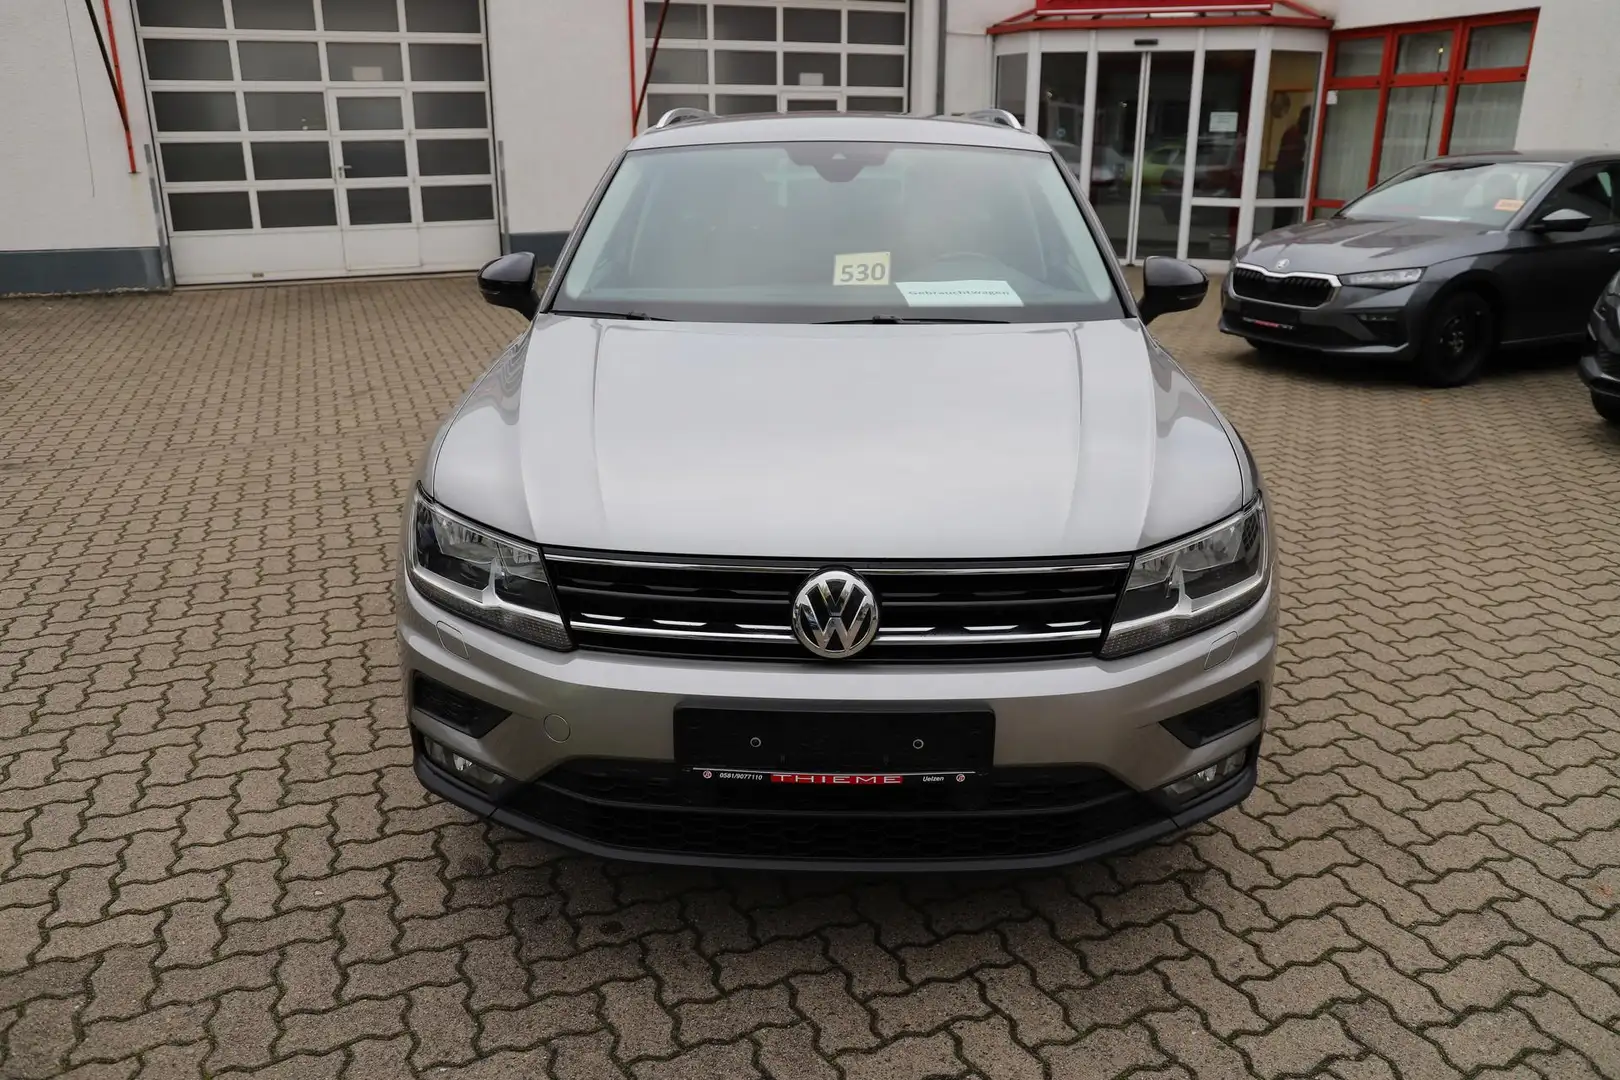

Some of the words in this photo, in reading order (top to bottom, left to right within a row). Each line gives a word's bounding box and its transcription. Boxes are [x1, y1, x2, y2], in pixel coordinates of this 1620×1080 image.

[840, 262, 886, 282] 530
[719, 772, 763, 781] 0581/9077110
[772, 774, 901, 784] THIEME
